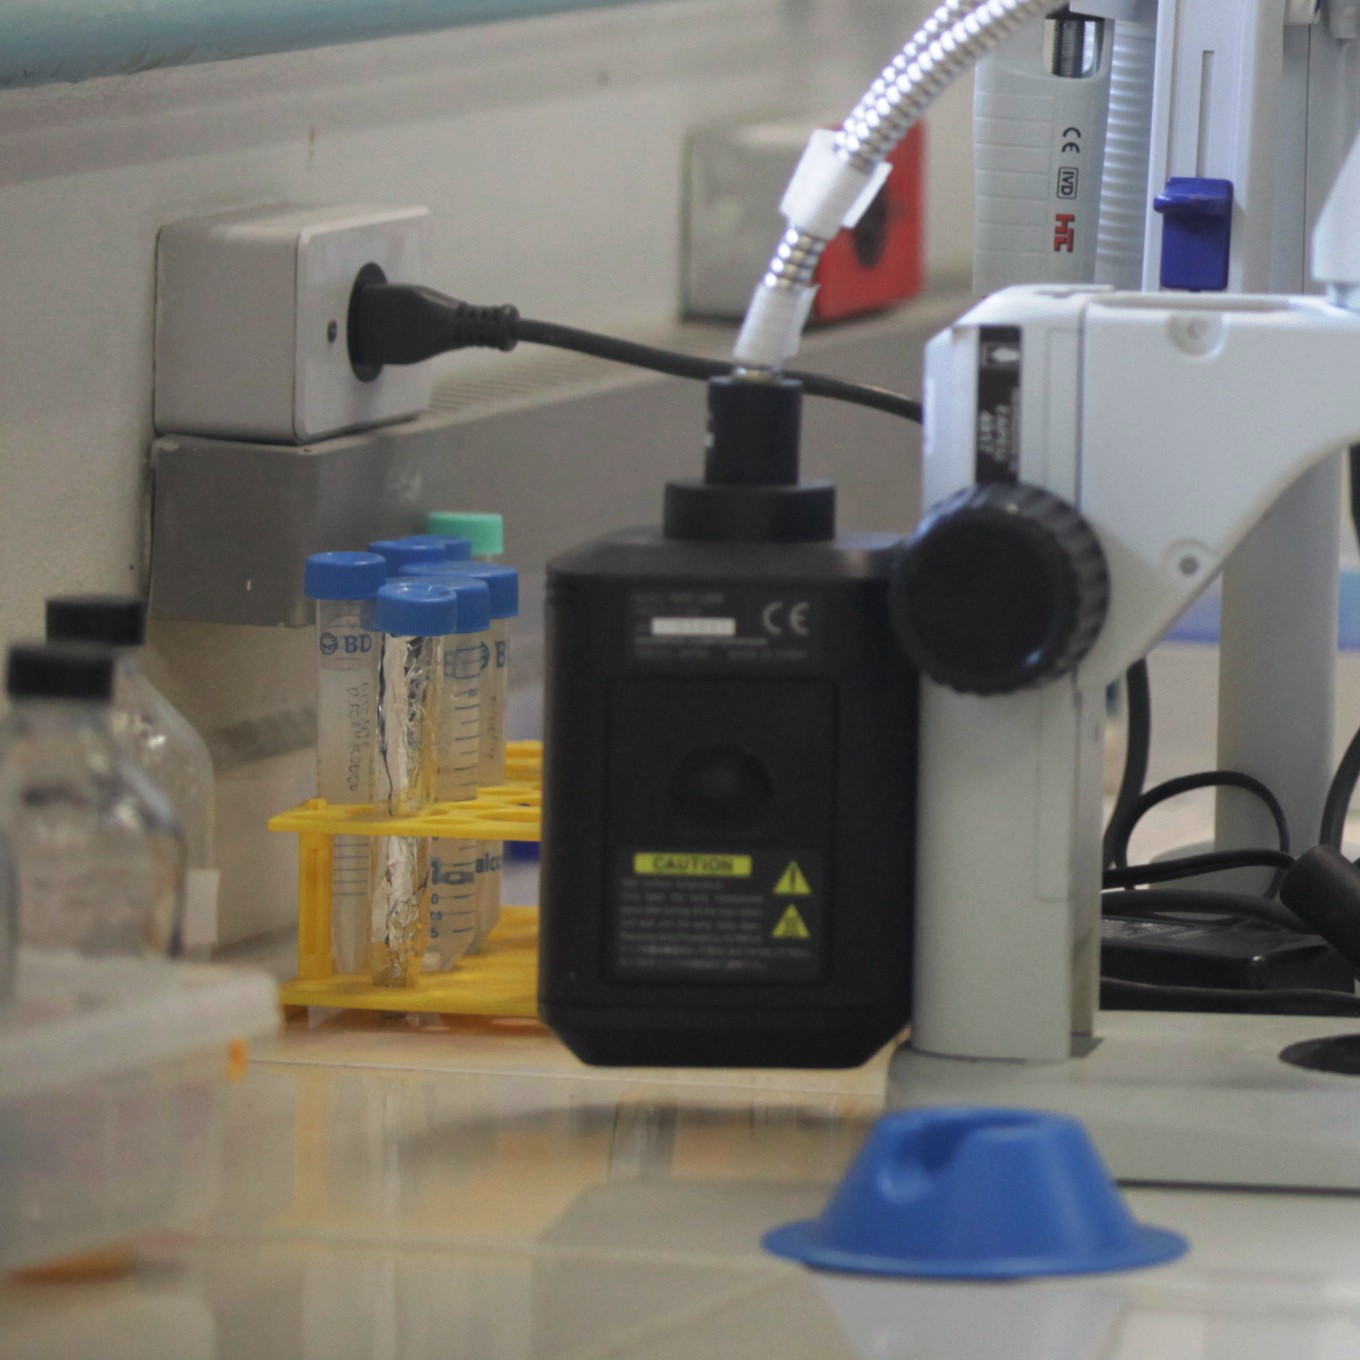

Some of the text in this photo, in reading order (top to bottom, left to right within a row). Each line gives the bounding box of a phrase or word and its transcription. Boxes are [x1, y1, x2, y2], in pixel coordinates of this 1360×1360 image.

[1060, 170, 1076, 197] IVD
[762, 601, 810, 635] CE
[343, 634, 373, 654] BD
[652, 855, 733, 873] CAUTION
